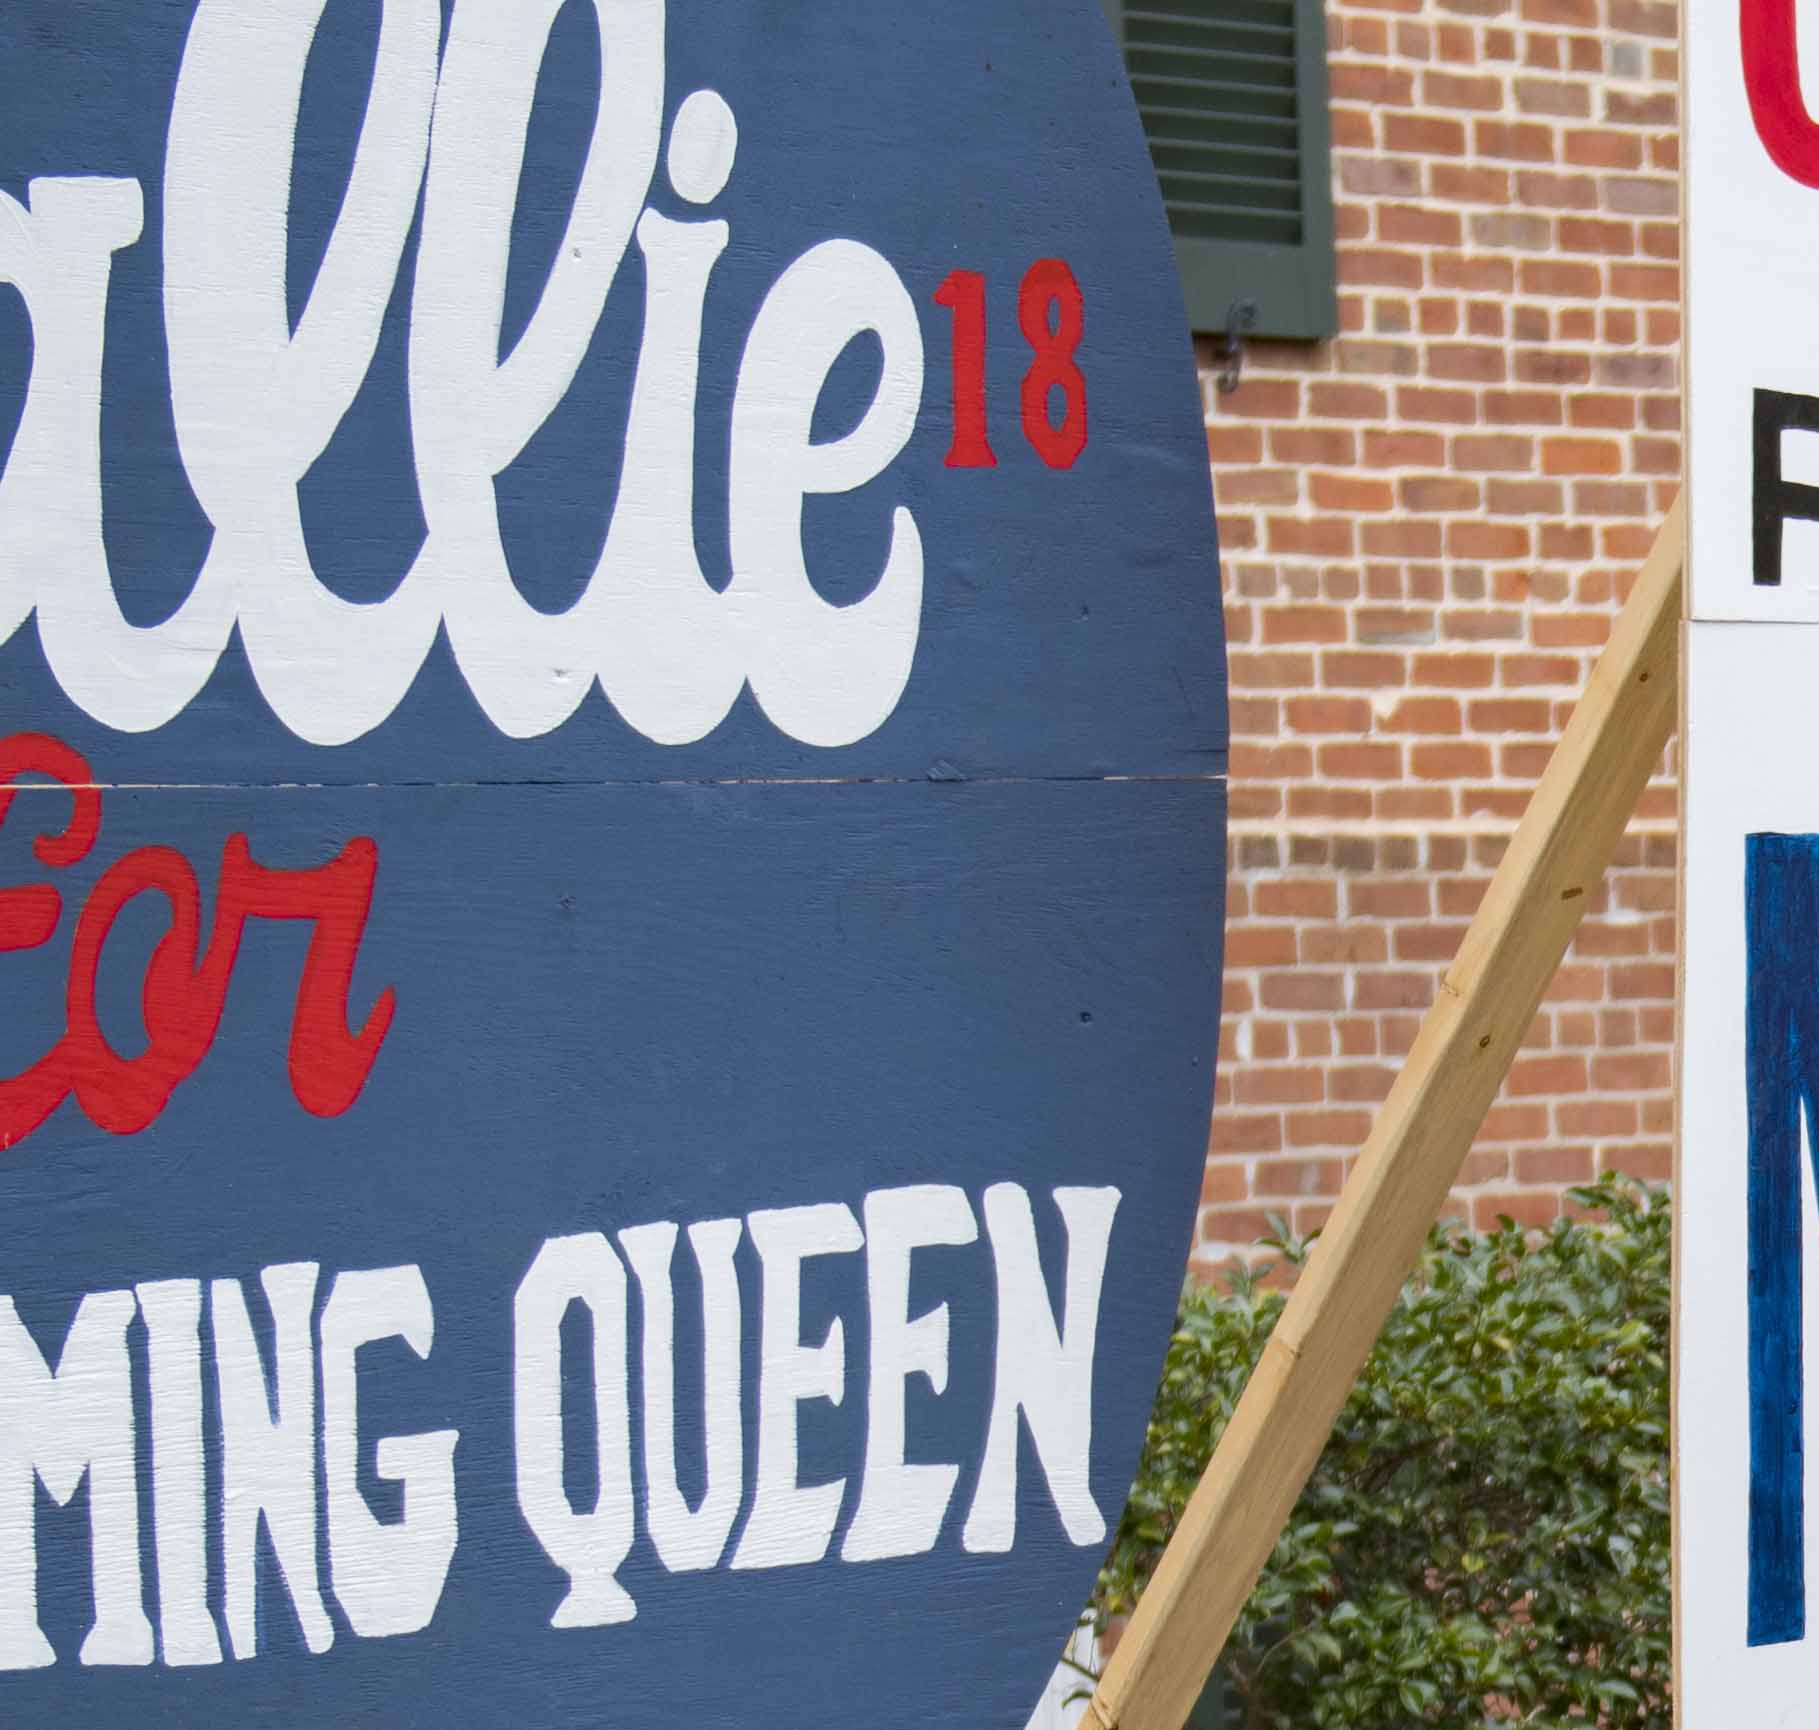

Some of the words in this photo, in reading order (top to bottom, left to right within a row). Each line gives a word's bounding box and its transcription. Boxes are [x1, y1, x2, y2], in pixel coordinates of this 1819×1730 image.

[933, 258, 1088, 470] 18
[0, 1261, 459, 1671] MING
[514, 1182, 1122, 1628] QUEEN
